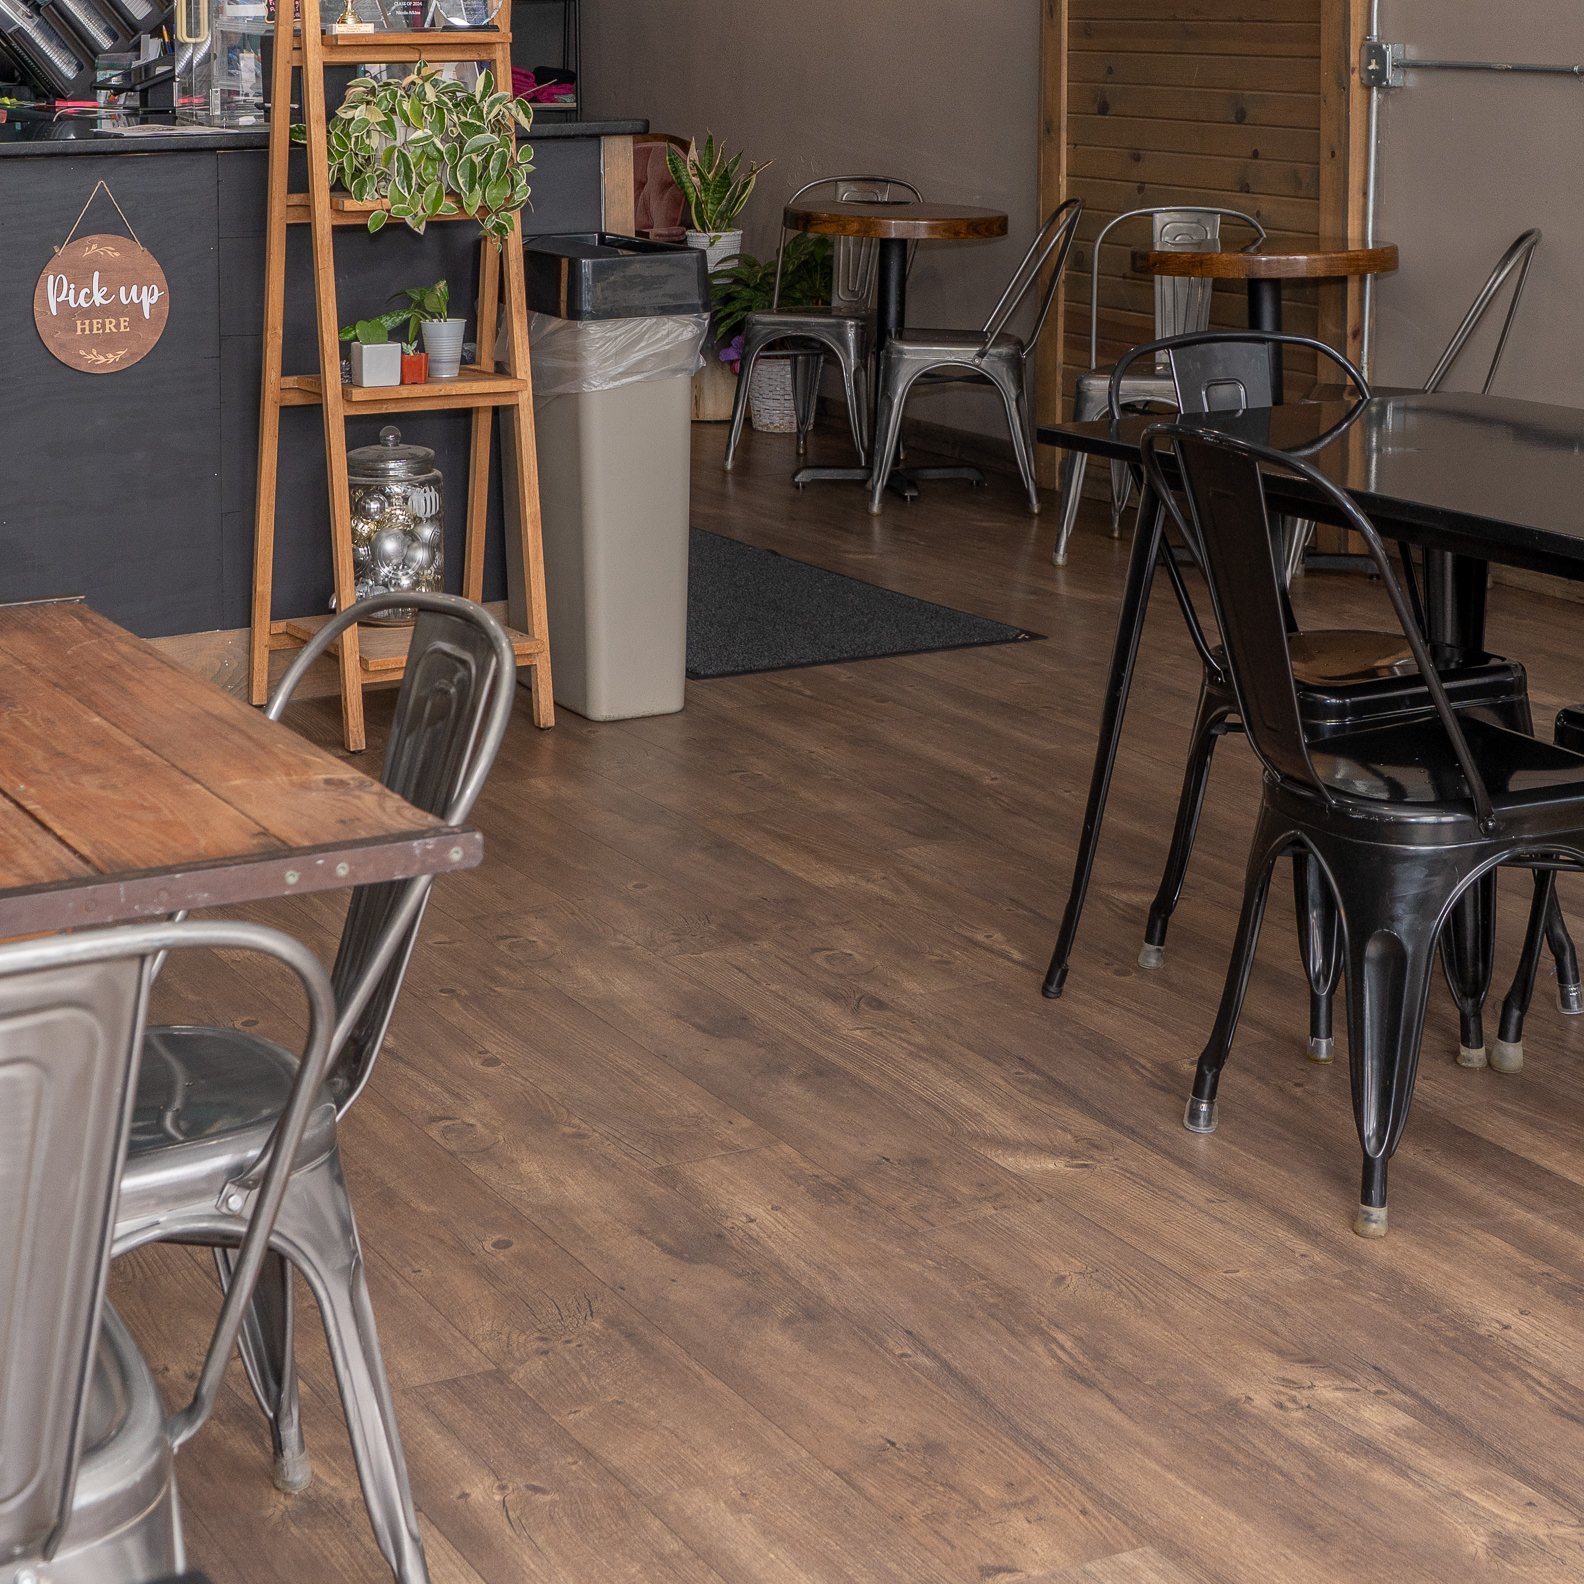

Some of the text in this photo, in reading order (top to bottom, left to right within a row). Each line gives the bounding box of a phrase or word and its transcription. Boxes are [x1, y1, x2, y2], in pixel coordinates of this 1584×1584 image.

[46, 270, 165, 320] Pick up
[75, 317, 131, 335] HERE
